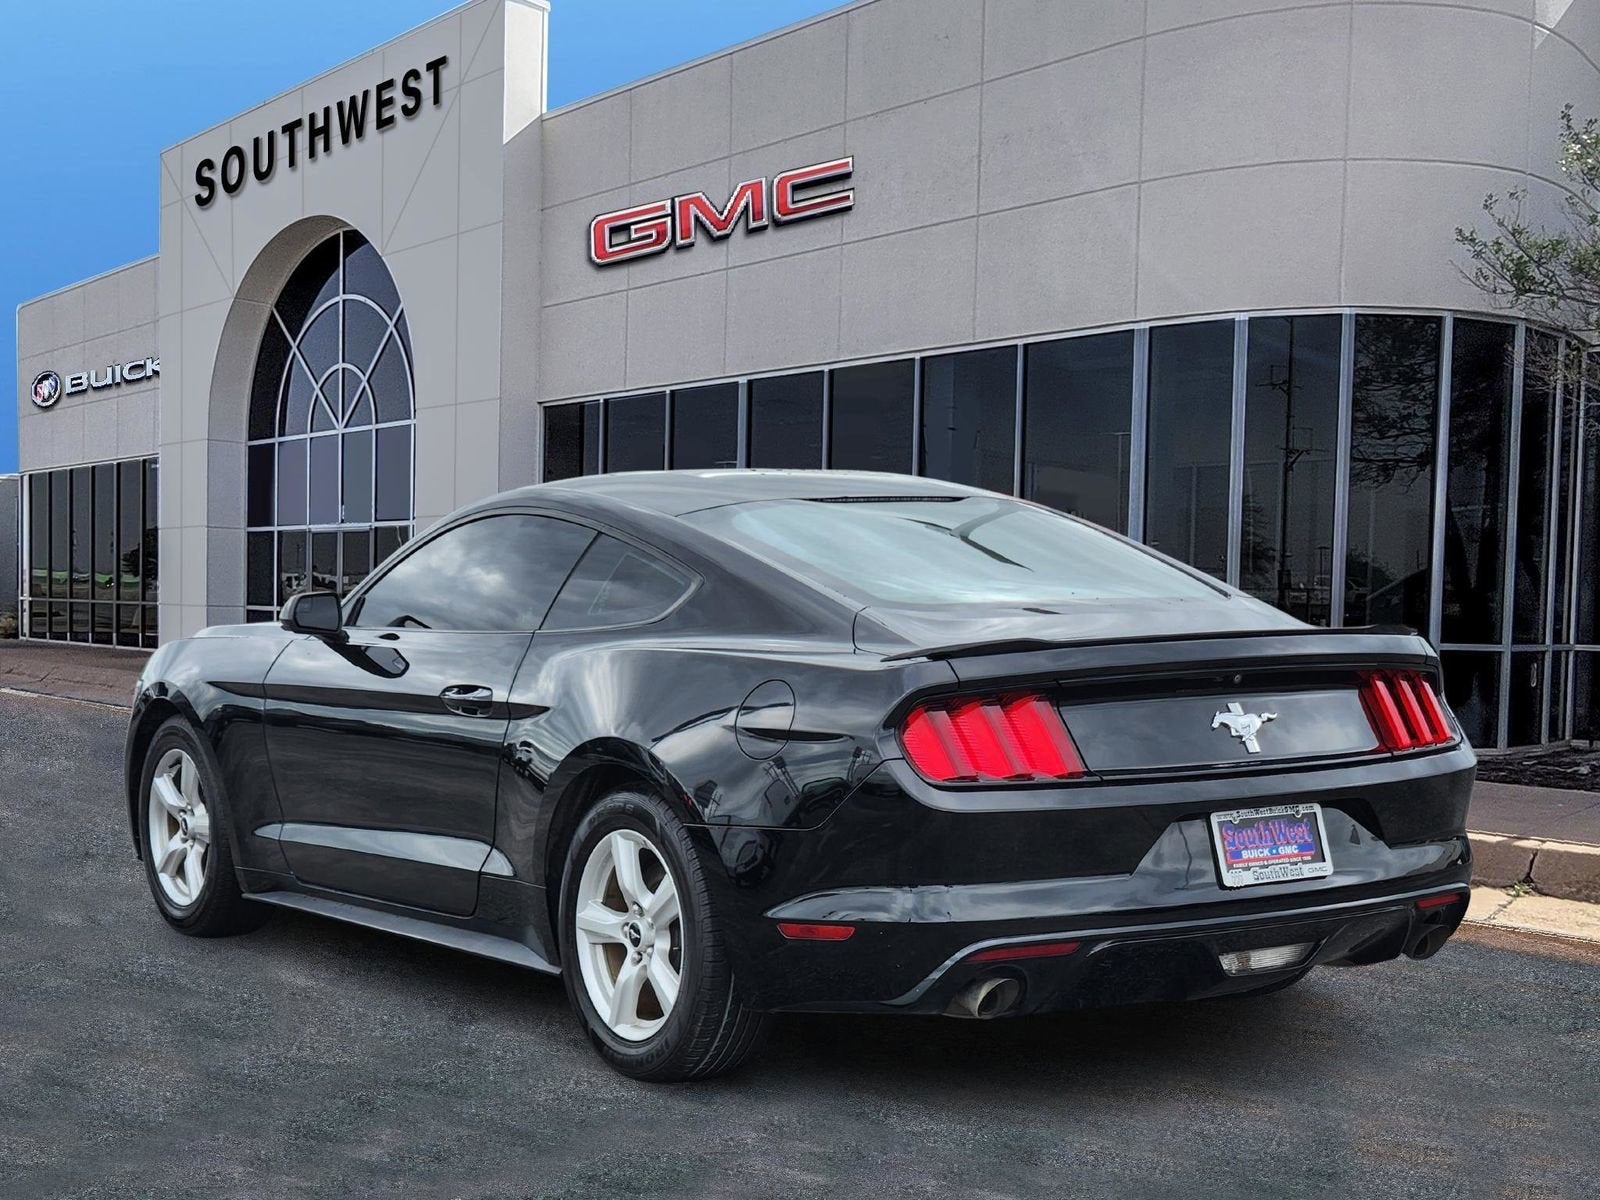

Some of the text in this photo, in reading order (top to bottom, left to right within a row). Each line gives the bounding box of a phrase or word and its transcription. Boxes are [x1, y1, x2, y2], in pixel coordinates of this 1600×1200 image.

[195, 55, 447, 207] SOUTHWEST
[589, 156, 854, 267] GMC
[65, 357, 160, 395] BUICK
[1222, 818, 1313, 850] SouthWest
[1241, 845, 1299, 859] BUICK GMC
[1252, 866, 1304, 881] SouthWest
